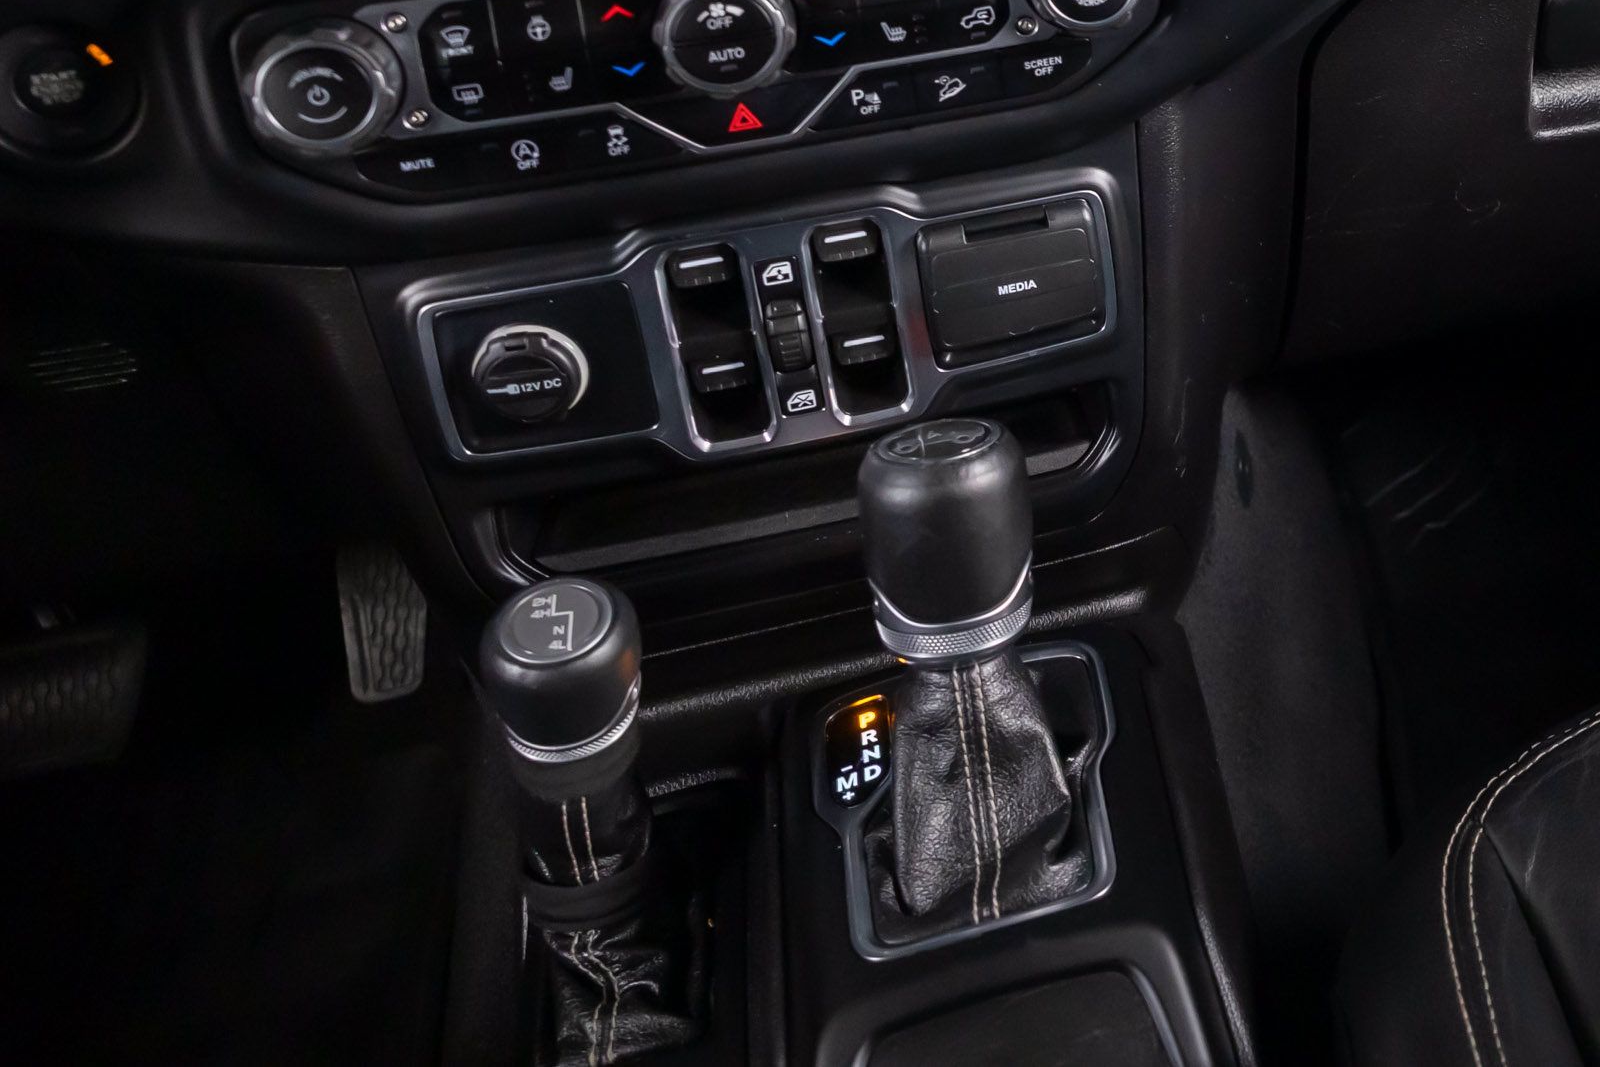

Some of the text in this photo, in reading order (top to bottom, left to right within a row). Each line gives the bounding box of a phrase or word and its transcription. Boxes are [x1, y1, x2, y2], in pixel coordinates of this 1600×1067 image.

[705, 15, 734, 30] OFF
[708, 46, 746, 63] AUTO
[1024, 55, 1064, 70] SCREEN
[1034, 65, 1054, 77] OFF
[851, 89, 864, 106] P
[860, 104, 881, 116] OFF
[607, 144, 632, 157] OFF
[399, 158, 436, 173] MUTE
[516, 158, 540, 171] OFF
[998, 279, 1037, 296] MEDIA
[520, 377, 563, 394] 12V DC
[857, 711, 876, 729] P
[860, 728, 879, 746] R
[861, 745, 881, 764] N
[864, 764, 882, 782] D
[837, 772, 858, 793] M
